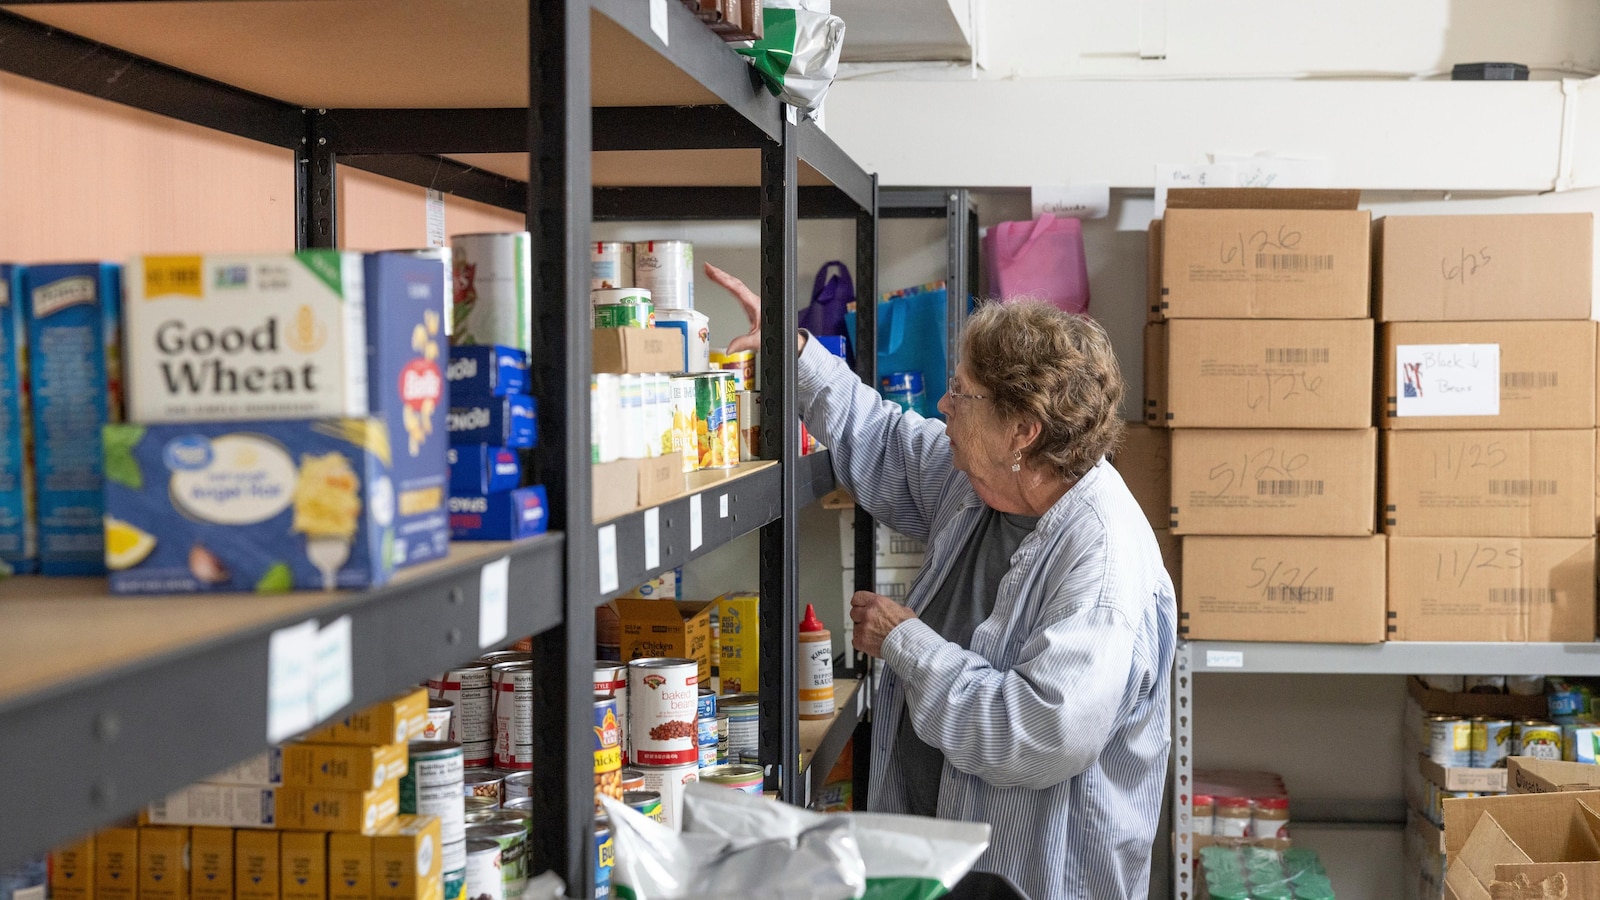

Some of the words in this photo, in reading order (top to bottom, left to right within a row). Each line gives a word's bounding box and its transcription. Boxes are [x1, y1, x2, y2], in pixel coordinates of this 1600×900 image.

[1441, 246, 1492, 285] 6/25
[156, 317, 279, 353] Good
[160, 357, 317, 394] Wheat
[448, 496, 488, 513] SPAG
[642, 641, 673, 652] Chicken
[662, 690, 692, 701] baked
[670, 700, 696, 710] beans
[593, 753, 614, 767] hick
